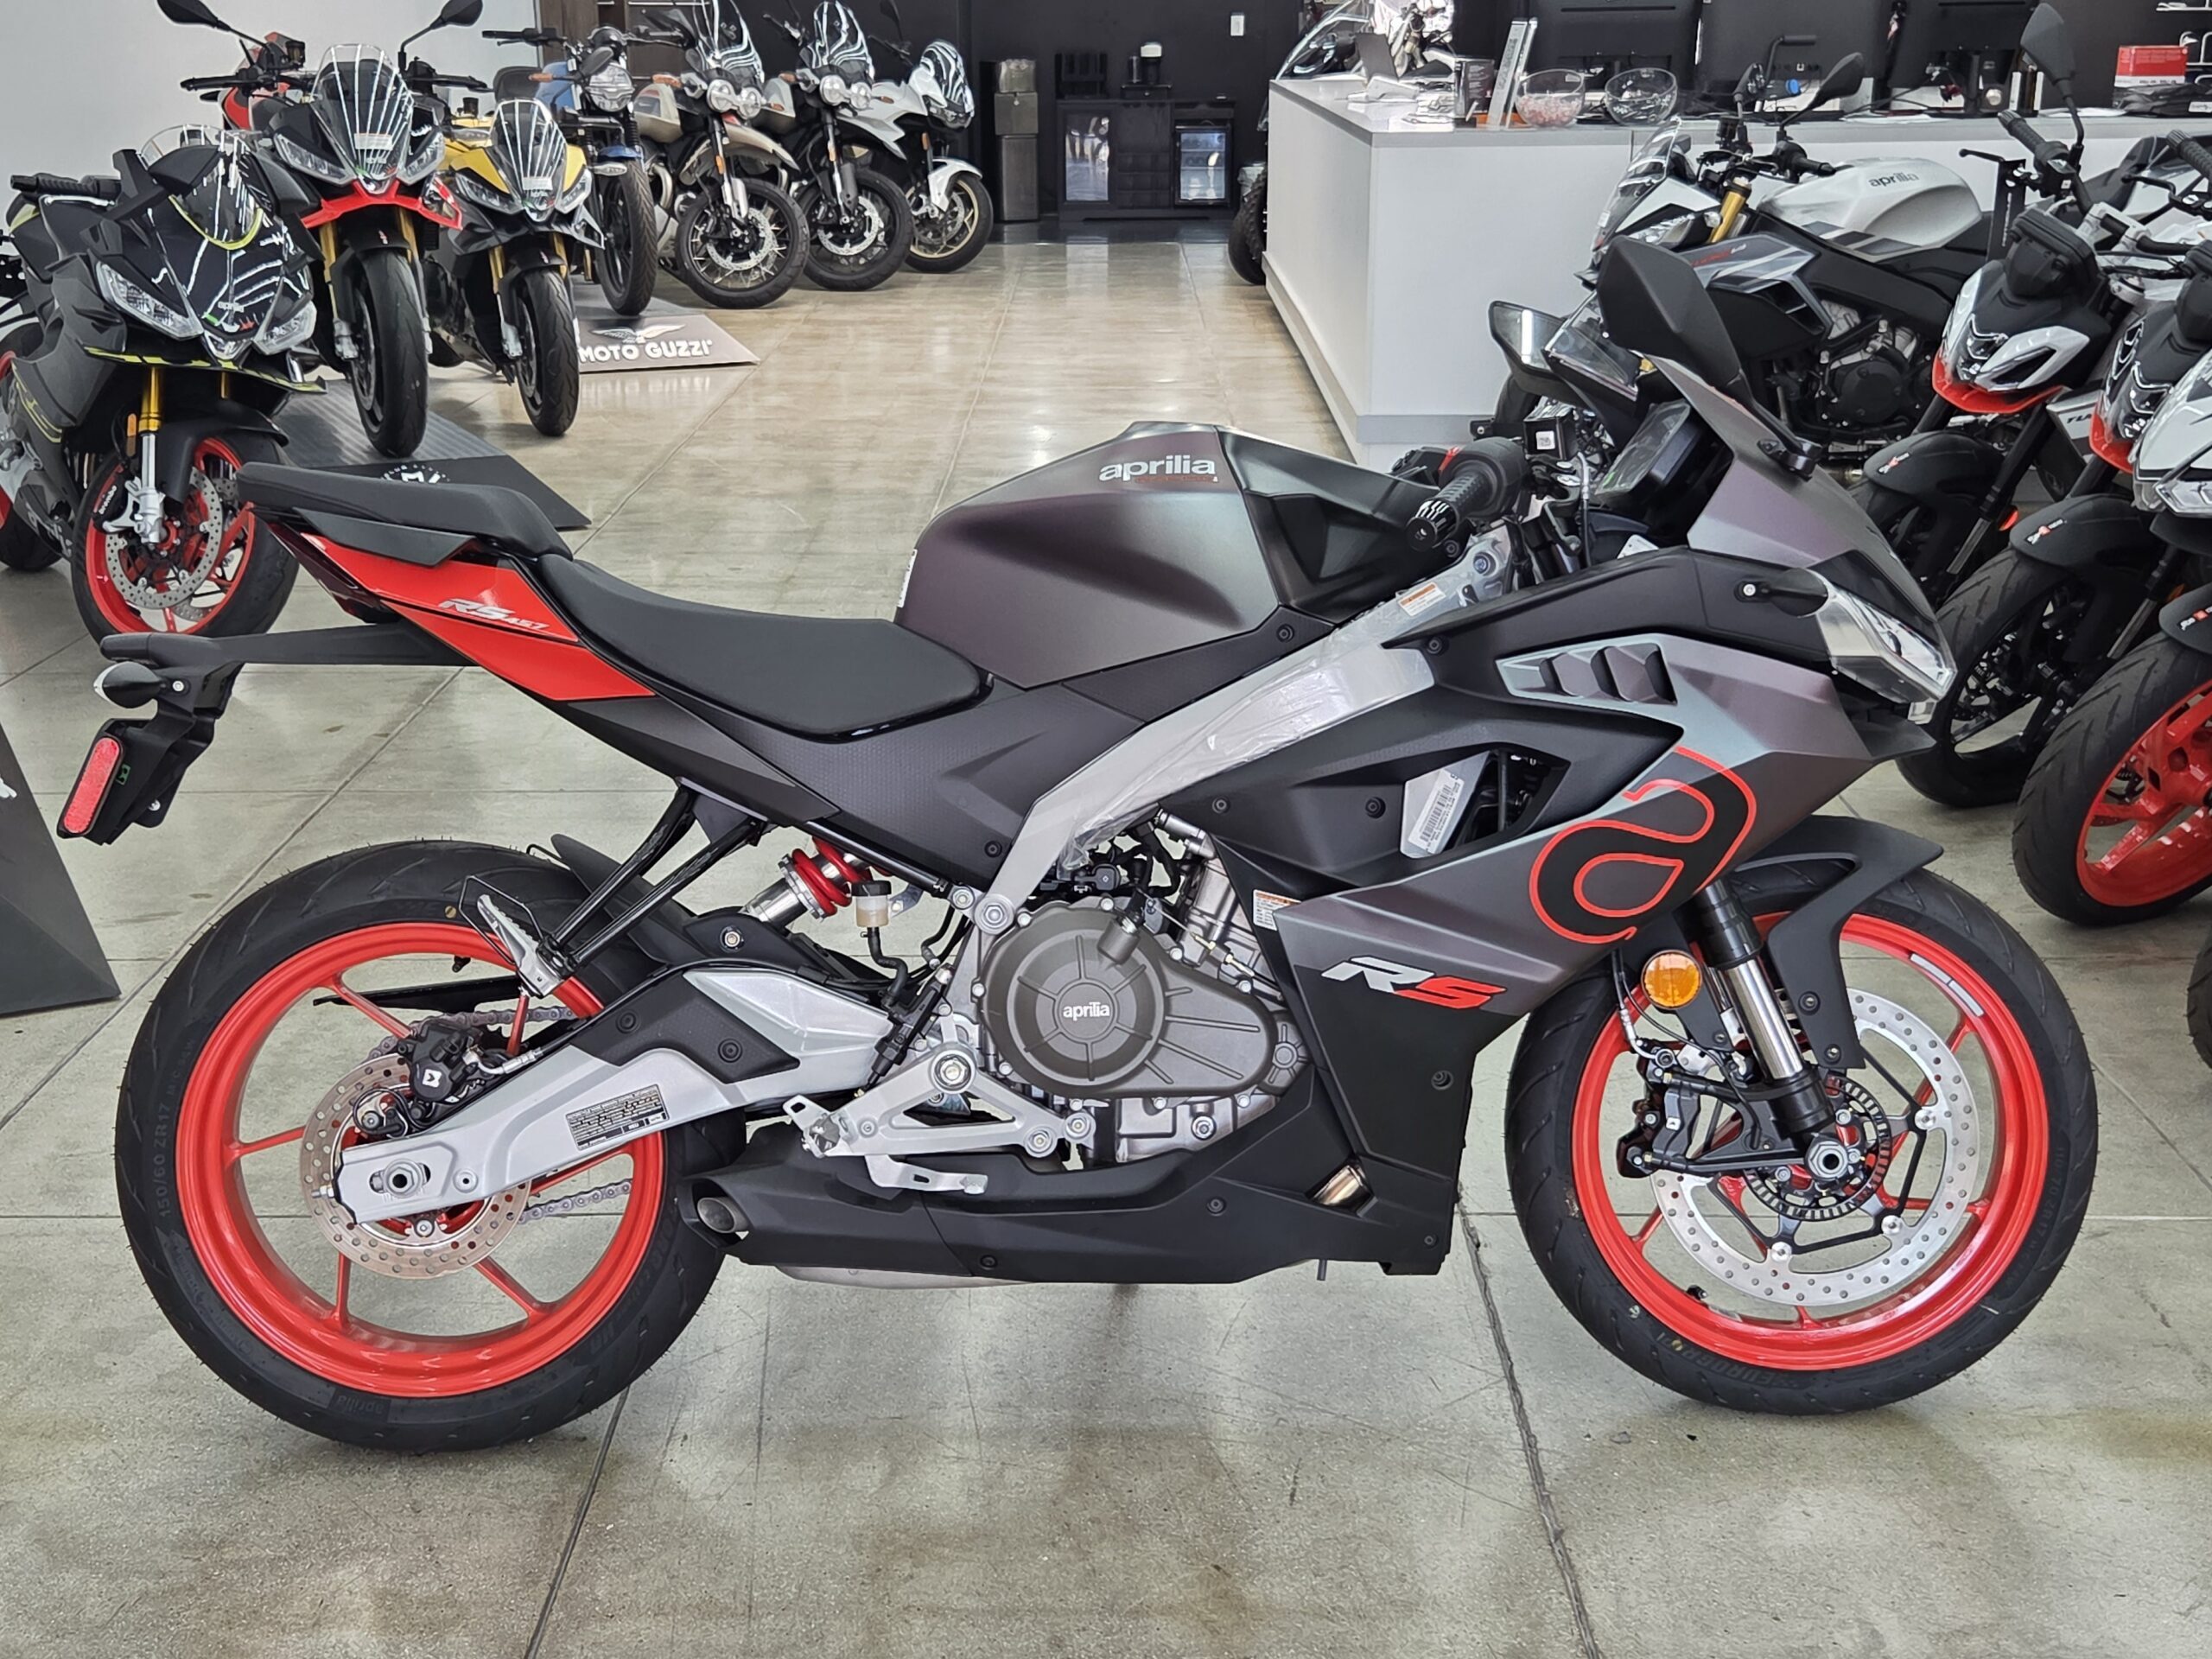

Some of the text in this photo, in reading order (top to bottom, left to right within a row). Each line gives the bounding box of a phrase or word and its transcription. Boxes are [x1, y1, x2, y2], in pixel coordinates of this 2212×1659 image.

[1868, 172, 1919, 187] aprilia
[578, 340, 711, 363] MOTO GUZZI
[1099, 454, 1216, 481] aprilia
[1321, 955, 1507, 1009] RS
[1063, 1001, 1109, 1021] aprilia
[1662, 1338, 1775, 1386] EUROGRP
